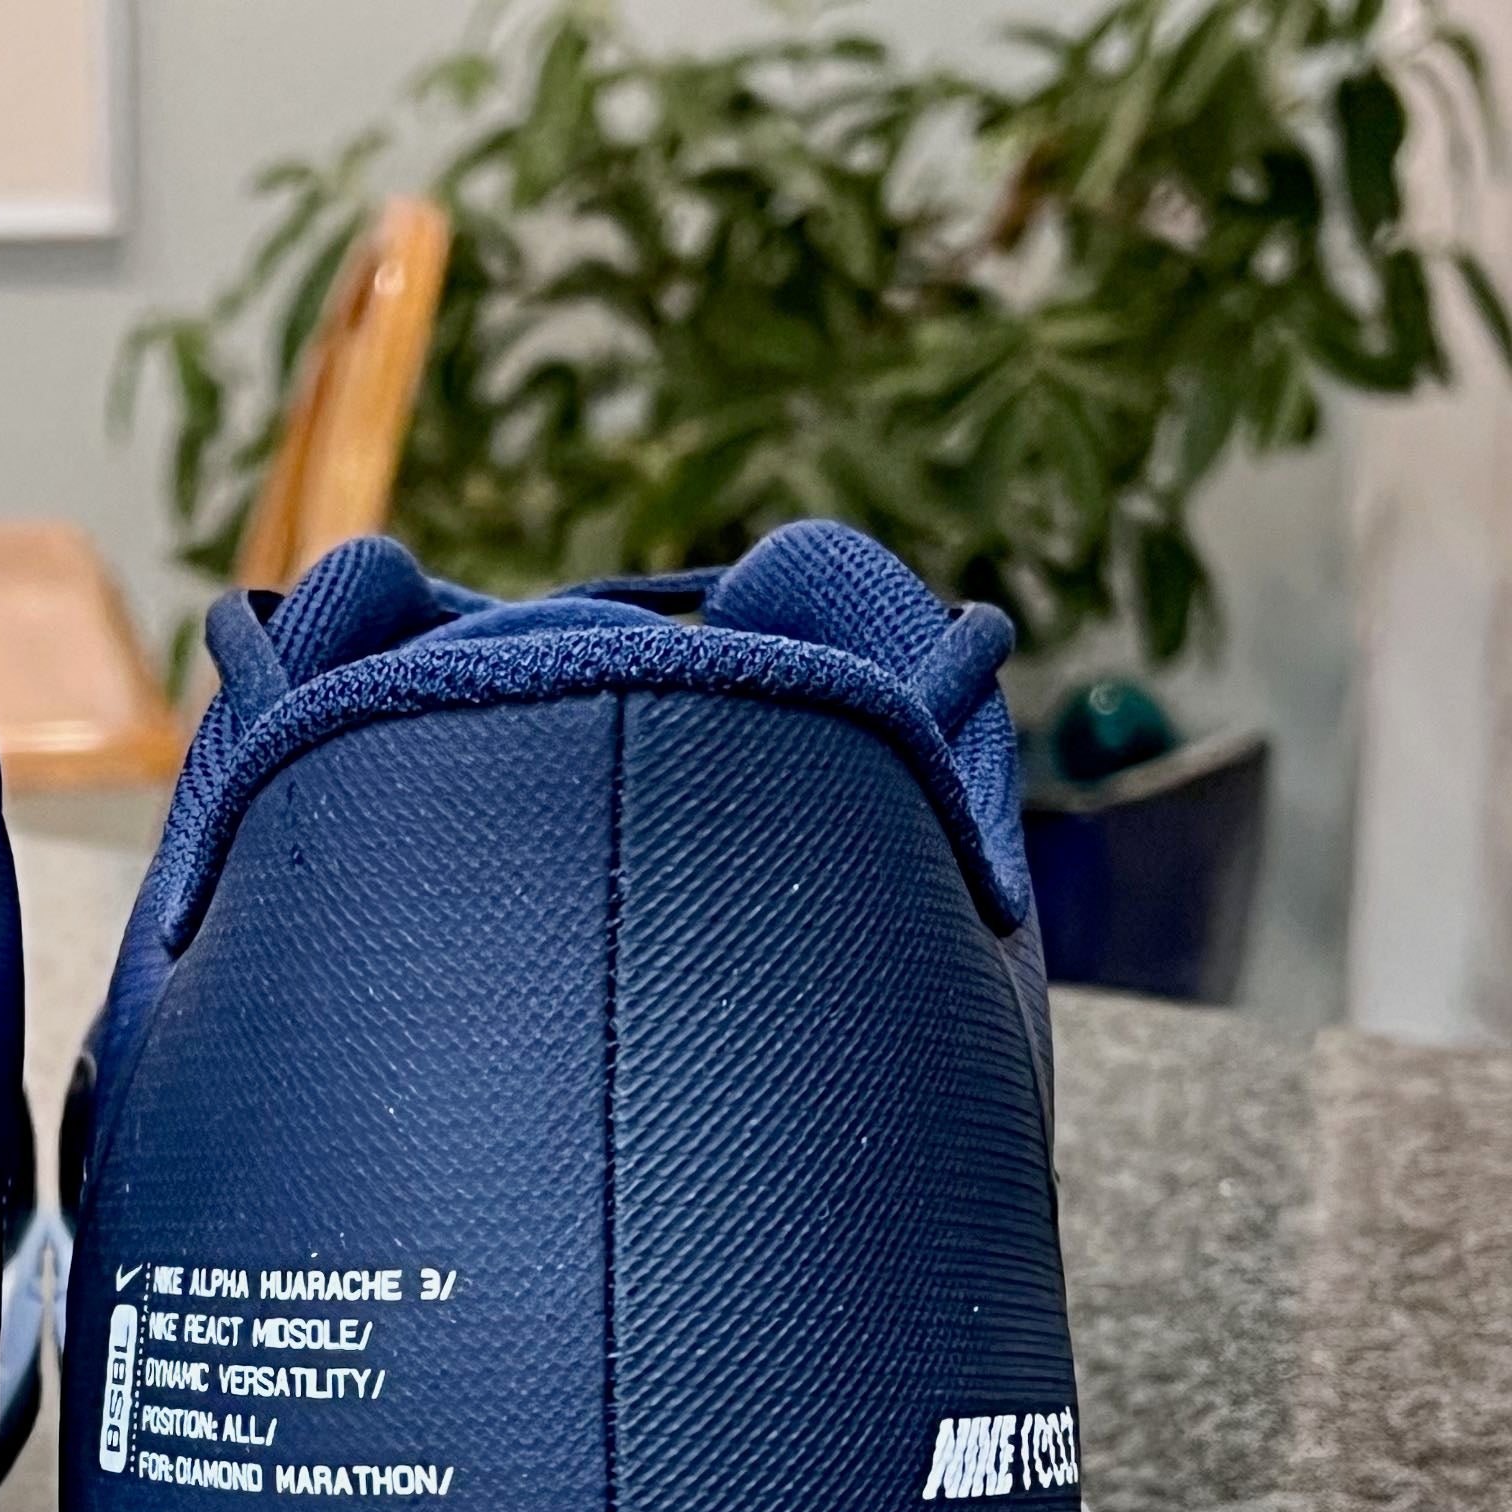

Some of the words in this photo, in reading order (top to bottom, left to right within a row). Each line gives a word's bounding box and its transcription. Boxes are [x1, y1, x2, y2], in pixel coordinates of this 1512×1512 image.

[152, 1266, 185, 1295] NIKE
[188, 1267, 249, 1299] ALPHA
[260, 1269, 403, 1302] HUARACHE
[420, 1267, 457, 1301] 3/
[149, 1311, 180, 1342] NIKE
[183, 1313, 244, 1347] REACT
[106, 1324, 130, 1452] BSBL
[145, 1357, 210, 1393] DYNAMIC
[218, 1364, 386, 1400] VERSATILITY/
[141, 1405, 219, 1441] POSITION:
[222, 1413, 278, 1447] ALL/
[138, 1451, 174, 1483] FOR:
[175, 1455, 263, 1492] DIAMOND
[275, 1464, 454, 1496] MARATHON/
[922, 1414, 1017, 1500] NIKE
